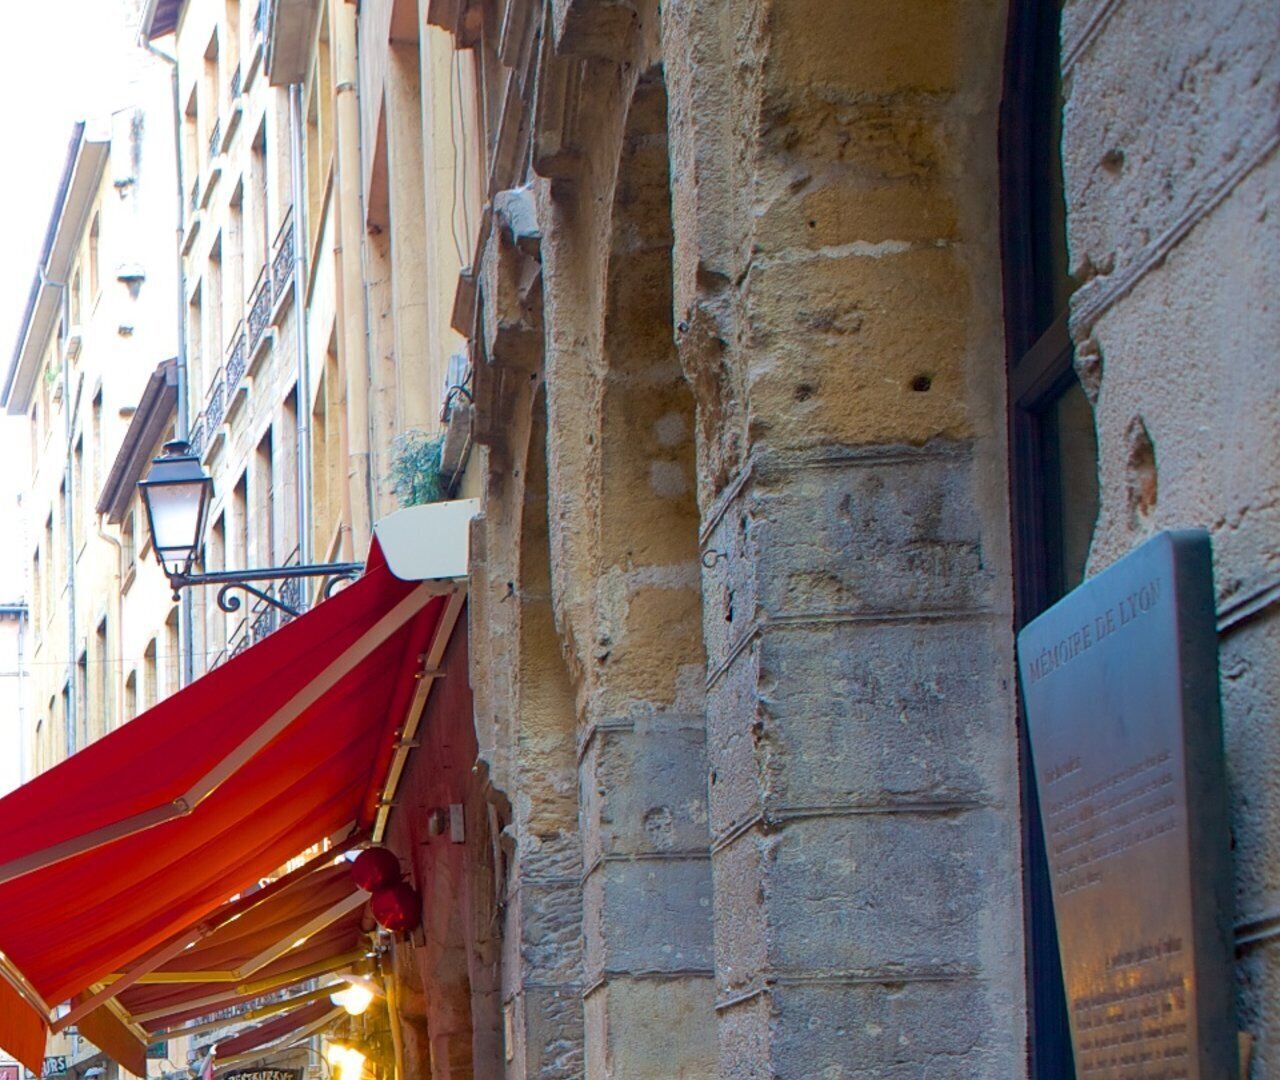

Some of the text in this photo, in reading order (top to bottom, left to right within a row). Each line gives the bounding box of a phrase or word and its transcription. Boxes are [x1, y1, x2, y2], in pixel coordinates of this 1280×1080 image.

[1028, 578, 1161, 684] MÉMOIRE DE LYON
